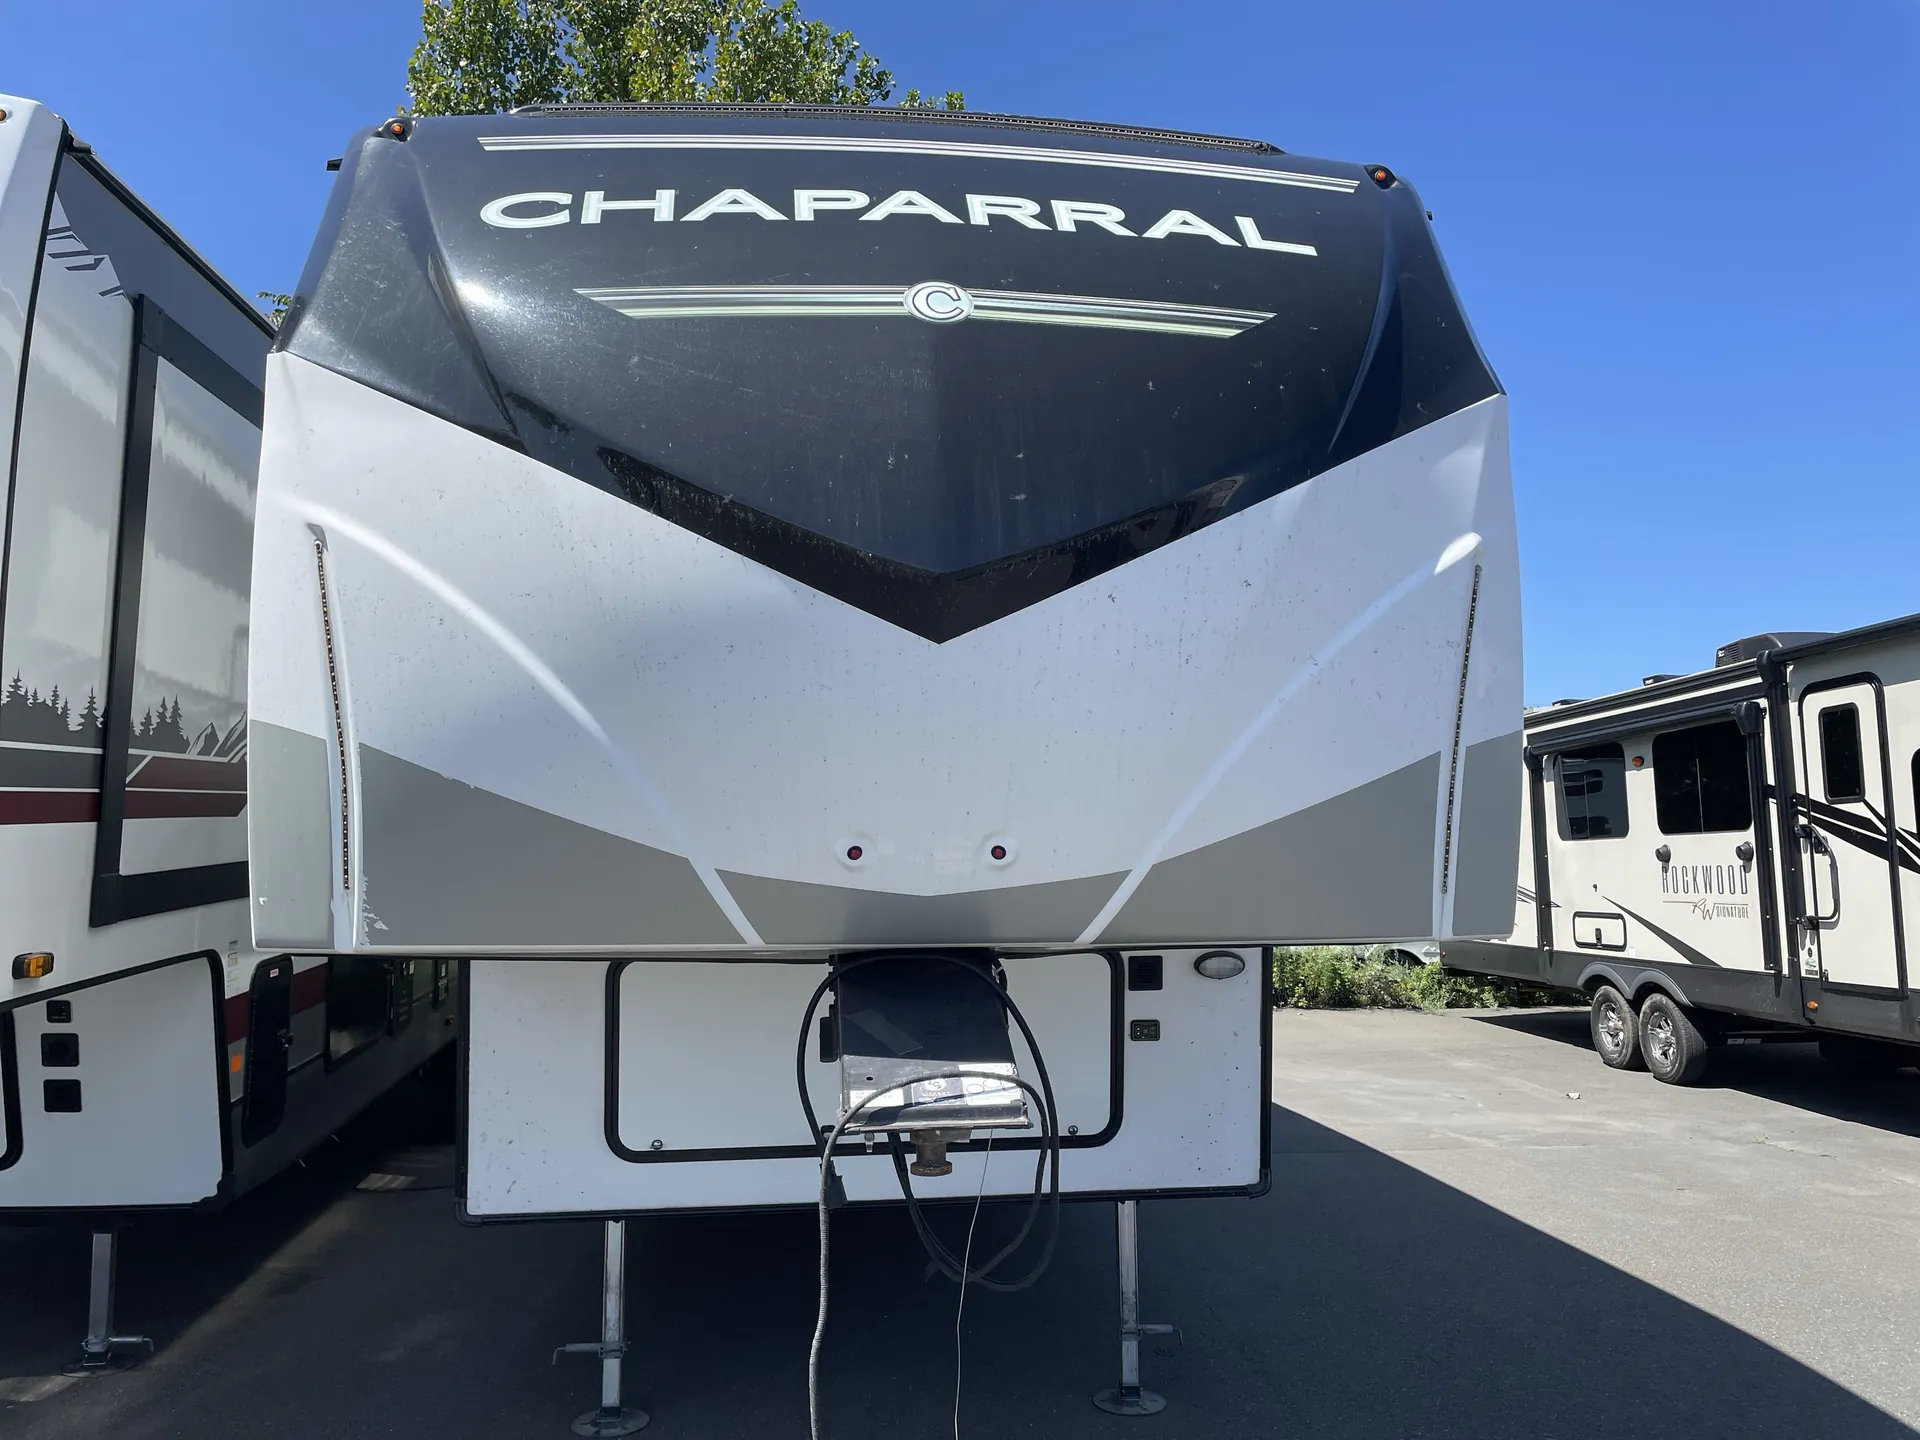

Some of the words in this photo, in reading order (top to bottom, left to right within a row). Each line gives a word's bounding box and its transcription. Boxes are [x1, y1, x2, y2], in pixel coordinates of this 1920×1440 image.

[479, 188, 1318, 257] CHAPARRAL
[913, 286, 964, 318] C
[1662, 865, 1748, 895] ROCKWOOD
[1716, 905, 1749, 919] SIGNATURE
